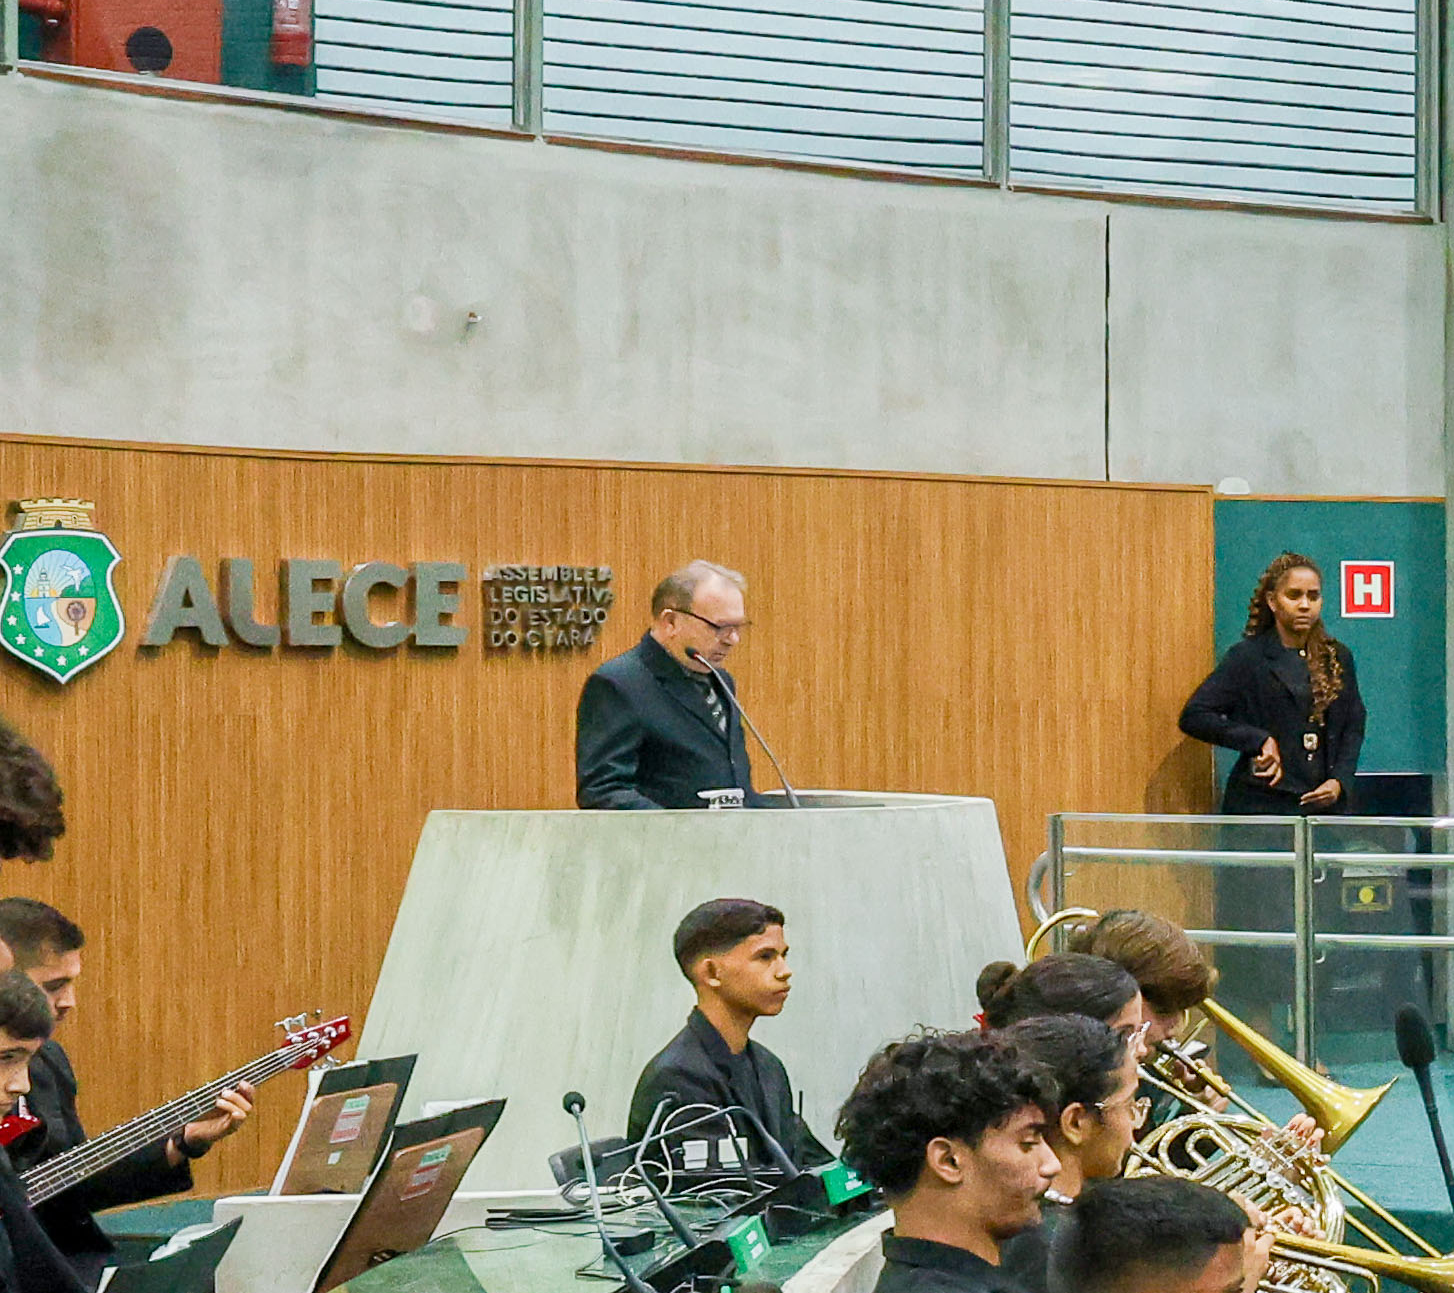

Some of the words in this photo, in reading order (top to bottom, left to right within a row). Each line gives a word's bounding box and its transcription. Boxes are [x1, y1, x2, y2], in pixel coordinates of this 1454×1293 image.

[483, 565, 614, 581] ASSEMBLEIA
[489, 585, 615, 603] LEGISLATIVA
[1353, 573, 1382, 605] H
[143, 555, 470, 649] ALECE
[491, 608, 519, 625] DO
[528, 607, 608, 626] ESTADO
[491, 630, 519, 647] DO
